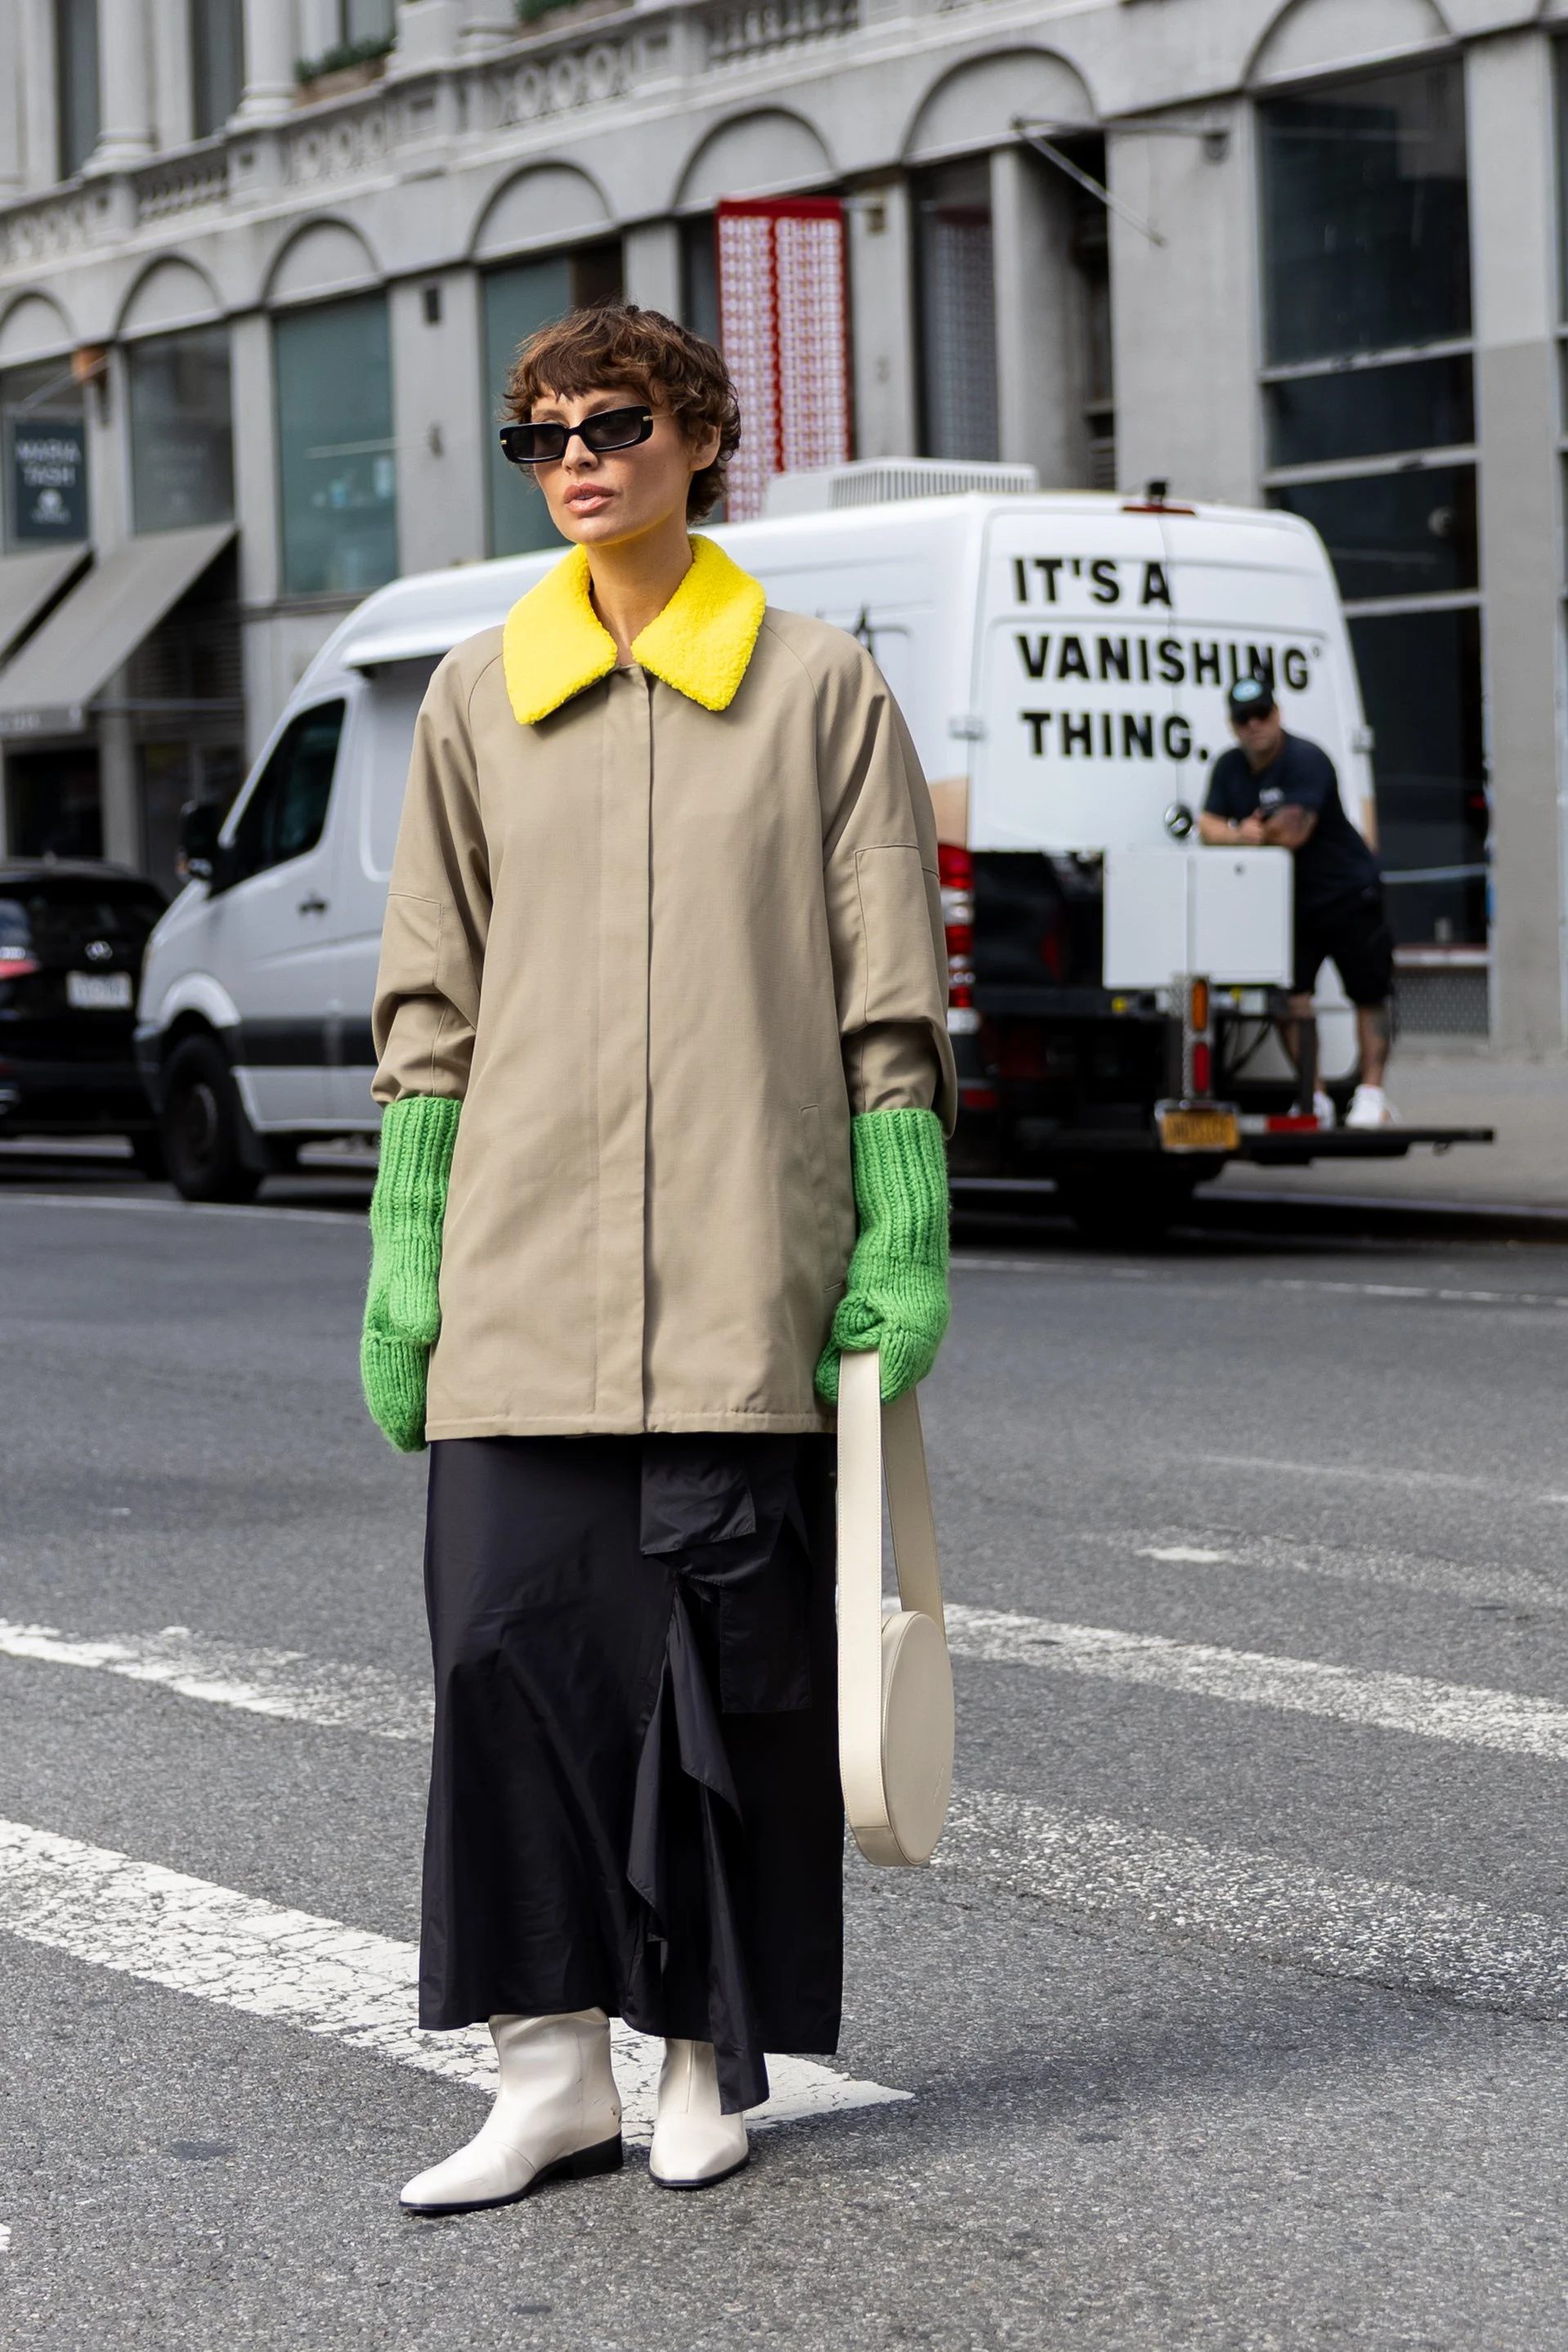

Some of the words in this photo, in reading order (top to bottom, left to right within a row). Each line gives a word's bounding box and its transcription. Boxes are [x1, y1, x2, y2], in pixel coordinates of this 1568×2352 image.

[1015, 558, 1121, 604] IT'S
[1141, 561, 1172, 607] A
[1017, 635, 1309, 691] VANISHING
[1021, 712, 1210, 761] THING.
